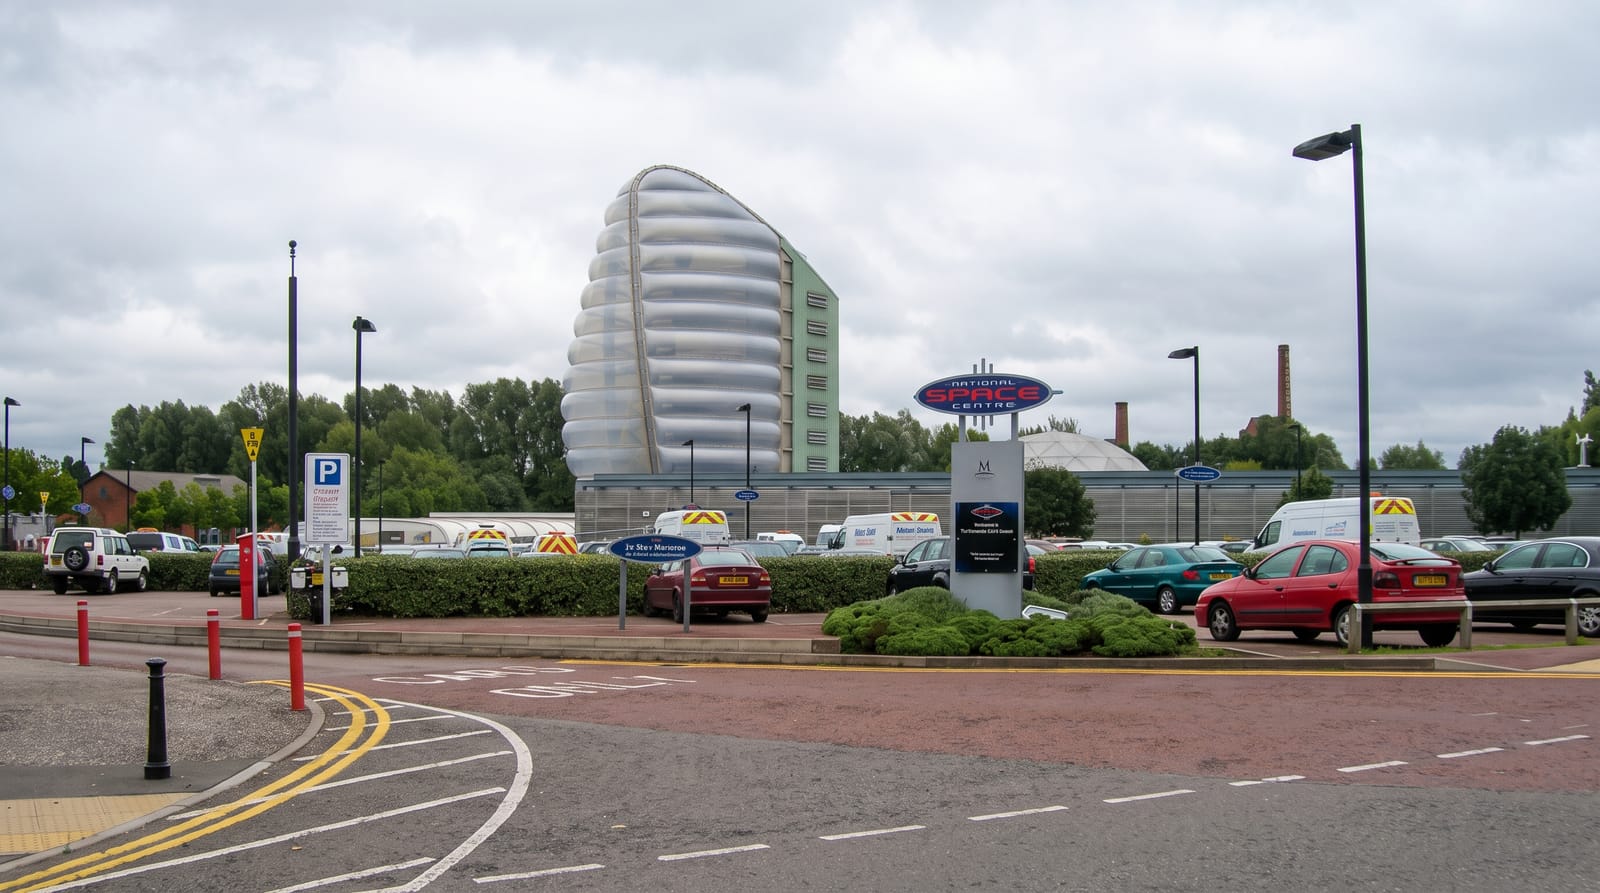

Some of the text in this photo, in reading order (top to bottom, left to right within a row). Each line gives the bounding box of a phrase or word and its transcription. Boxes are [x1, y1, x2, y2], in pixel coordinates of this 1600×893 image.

[925, 386, 1041, 403] SPACE
[319, 460, 338, 483] P
[978, 459, 991, 472] M
